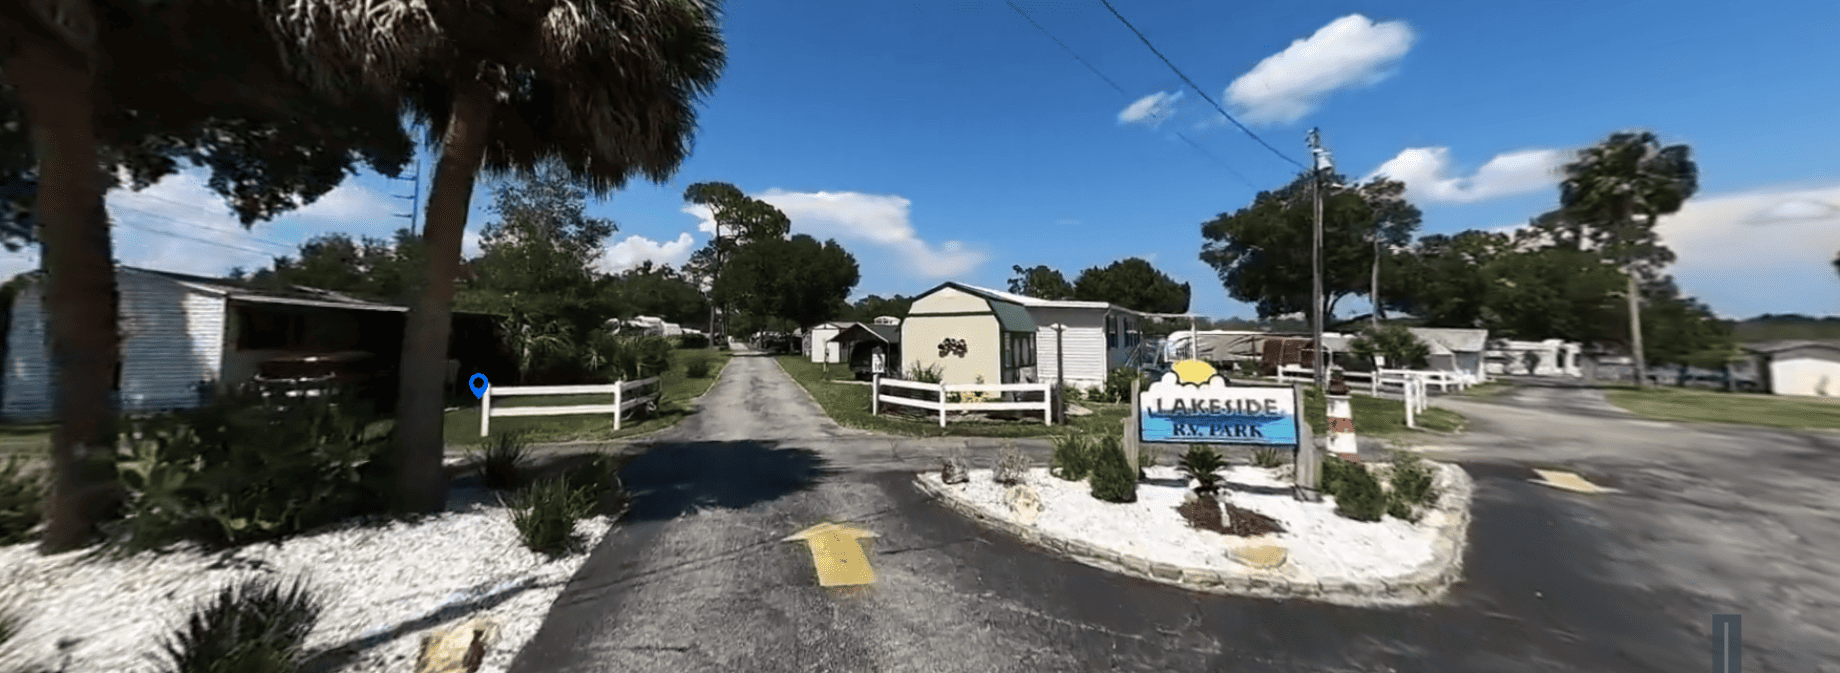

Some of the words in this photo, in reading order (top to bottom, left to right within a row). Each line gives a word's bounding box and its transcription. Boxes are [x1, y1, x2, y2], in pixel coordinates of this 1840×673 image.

[1156, 398, 1279, 415] LAKESIDE
[1173, 423, 1204, 436] R.V.
[1210, 423, 1264, 438] PARK
